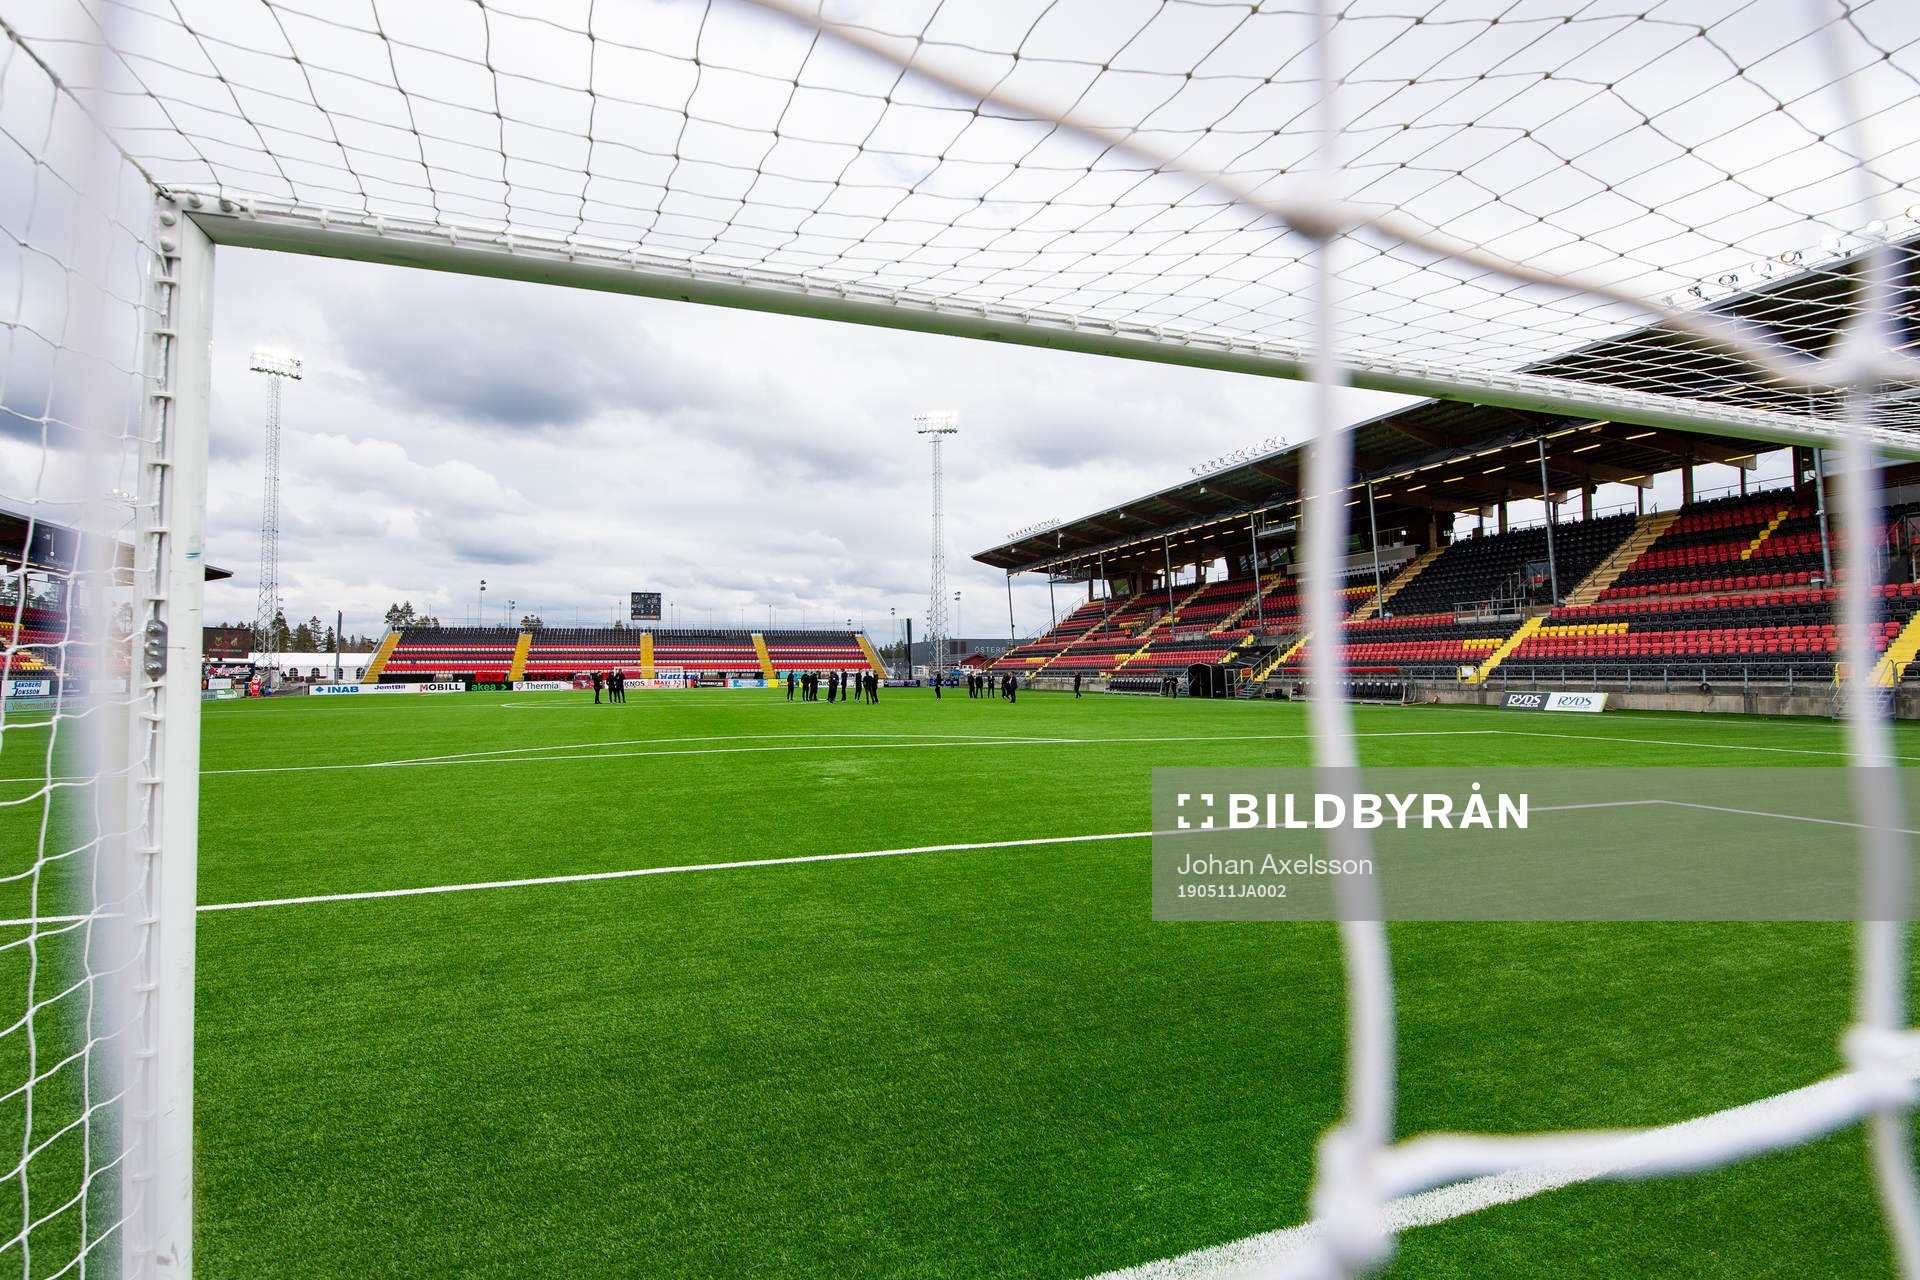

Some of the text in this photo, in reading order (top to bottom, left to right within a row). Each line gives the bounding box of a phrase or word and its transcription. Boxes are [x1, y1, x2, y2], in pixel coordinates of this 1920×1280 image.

[420, 684, 460, 692] MOBILL
[471, 682, 496, 691] akea
[526, 682, 559, 690] Thermia
[13, 688, 40, 696] JONSSON
[1508, 694, 1541, 704] RYDS
[1557, 696, 1592, 706] RYDS
